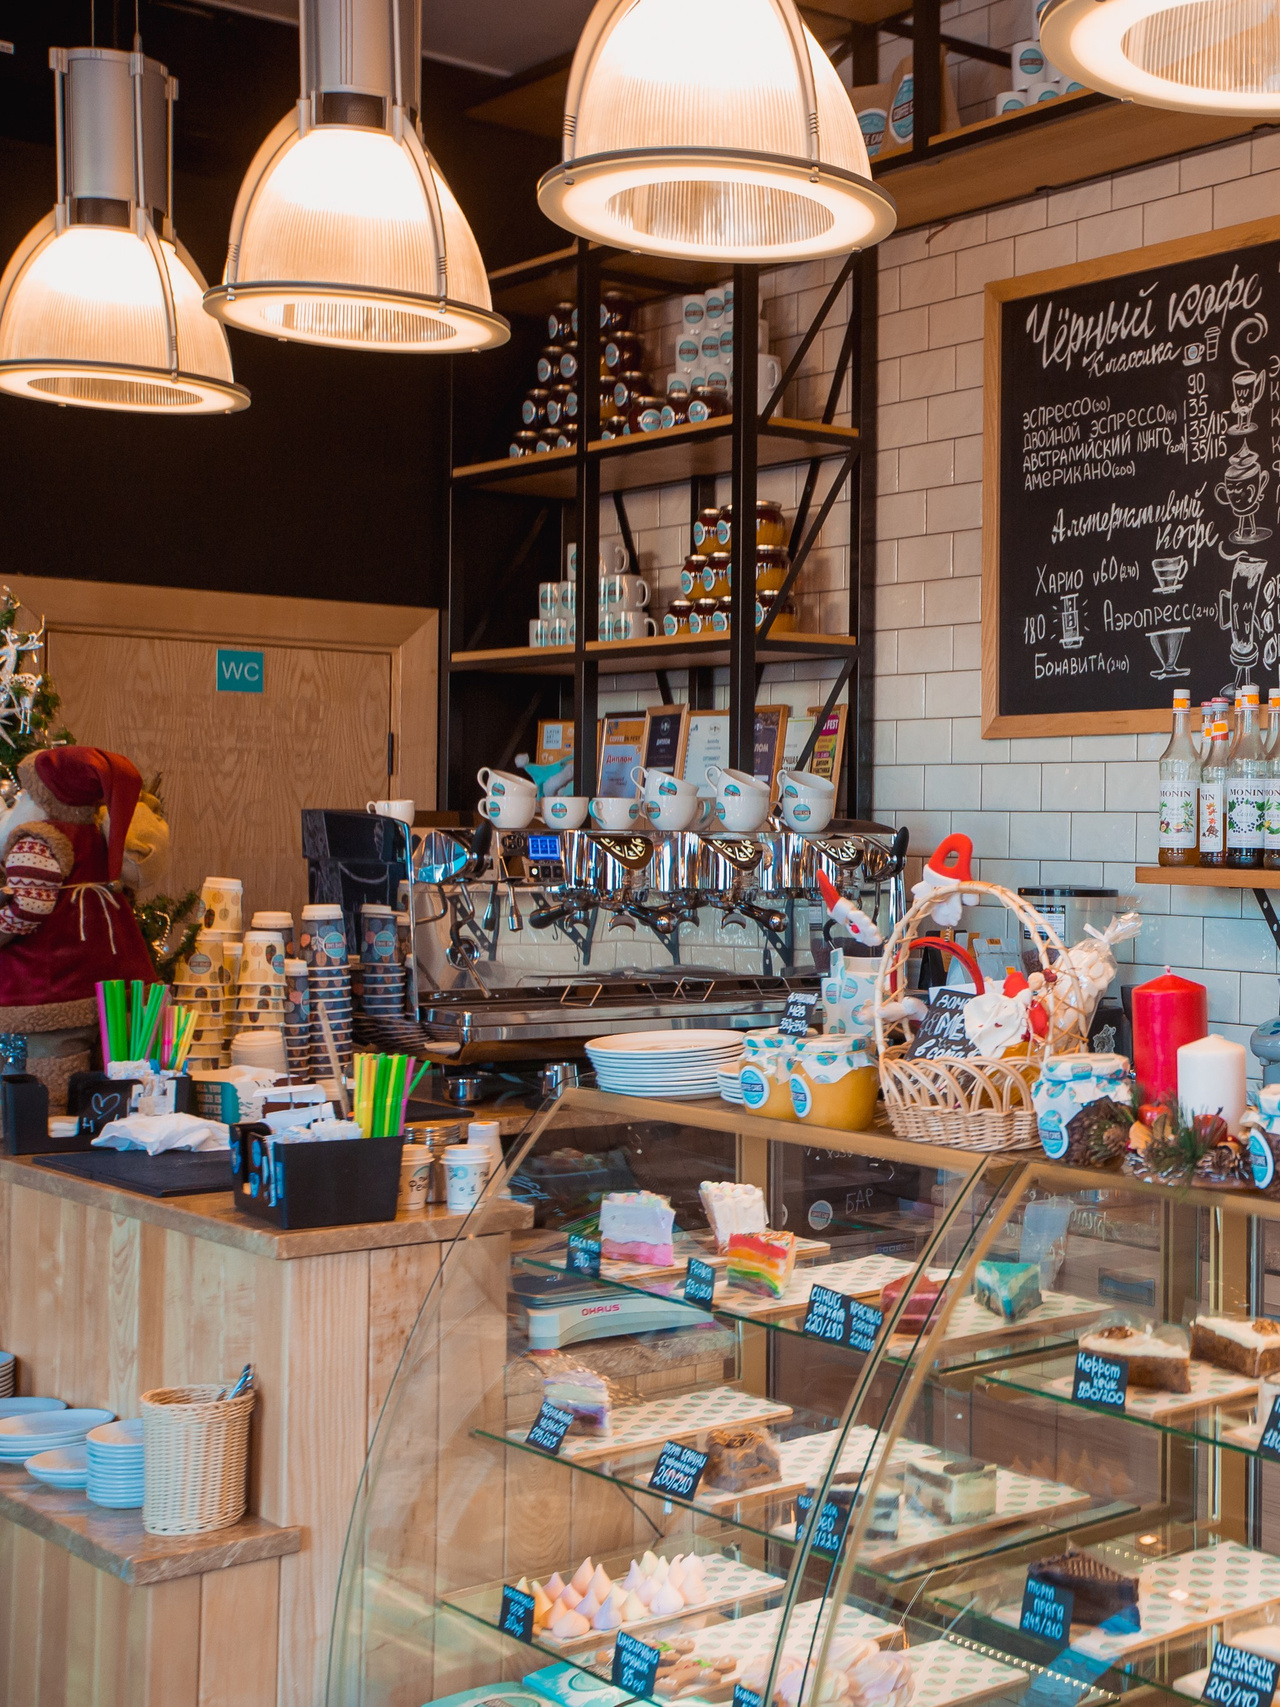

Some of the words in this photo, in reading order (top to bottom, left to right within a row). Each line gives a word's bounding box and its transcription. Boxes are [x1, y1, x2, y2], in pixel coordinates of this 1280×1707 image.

[1083, 341, 1182, 378] Классика
[1024, 421, 1081, 452] ДВОЙНОЙ
[1023, 430, 1131, 473] АВСТРАЛИЙСКИЙ
[1136, 427, 1172, 453] ЛУНГО
[221, 660, 260, 682] WC
[606, 754, 633, 765] Диплом
[754, 743, 769, 753] ЛОМ
[1230, 788, 1264, 797] MONIN
[845, 1187, 874, 1215] БАР
[581, 1303, 621, 1317] OHAUS
[804, 1312, 845, 1341] 220/180
